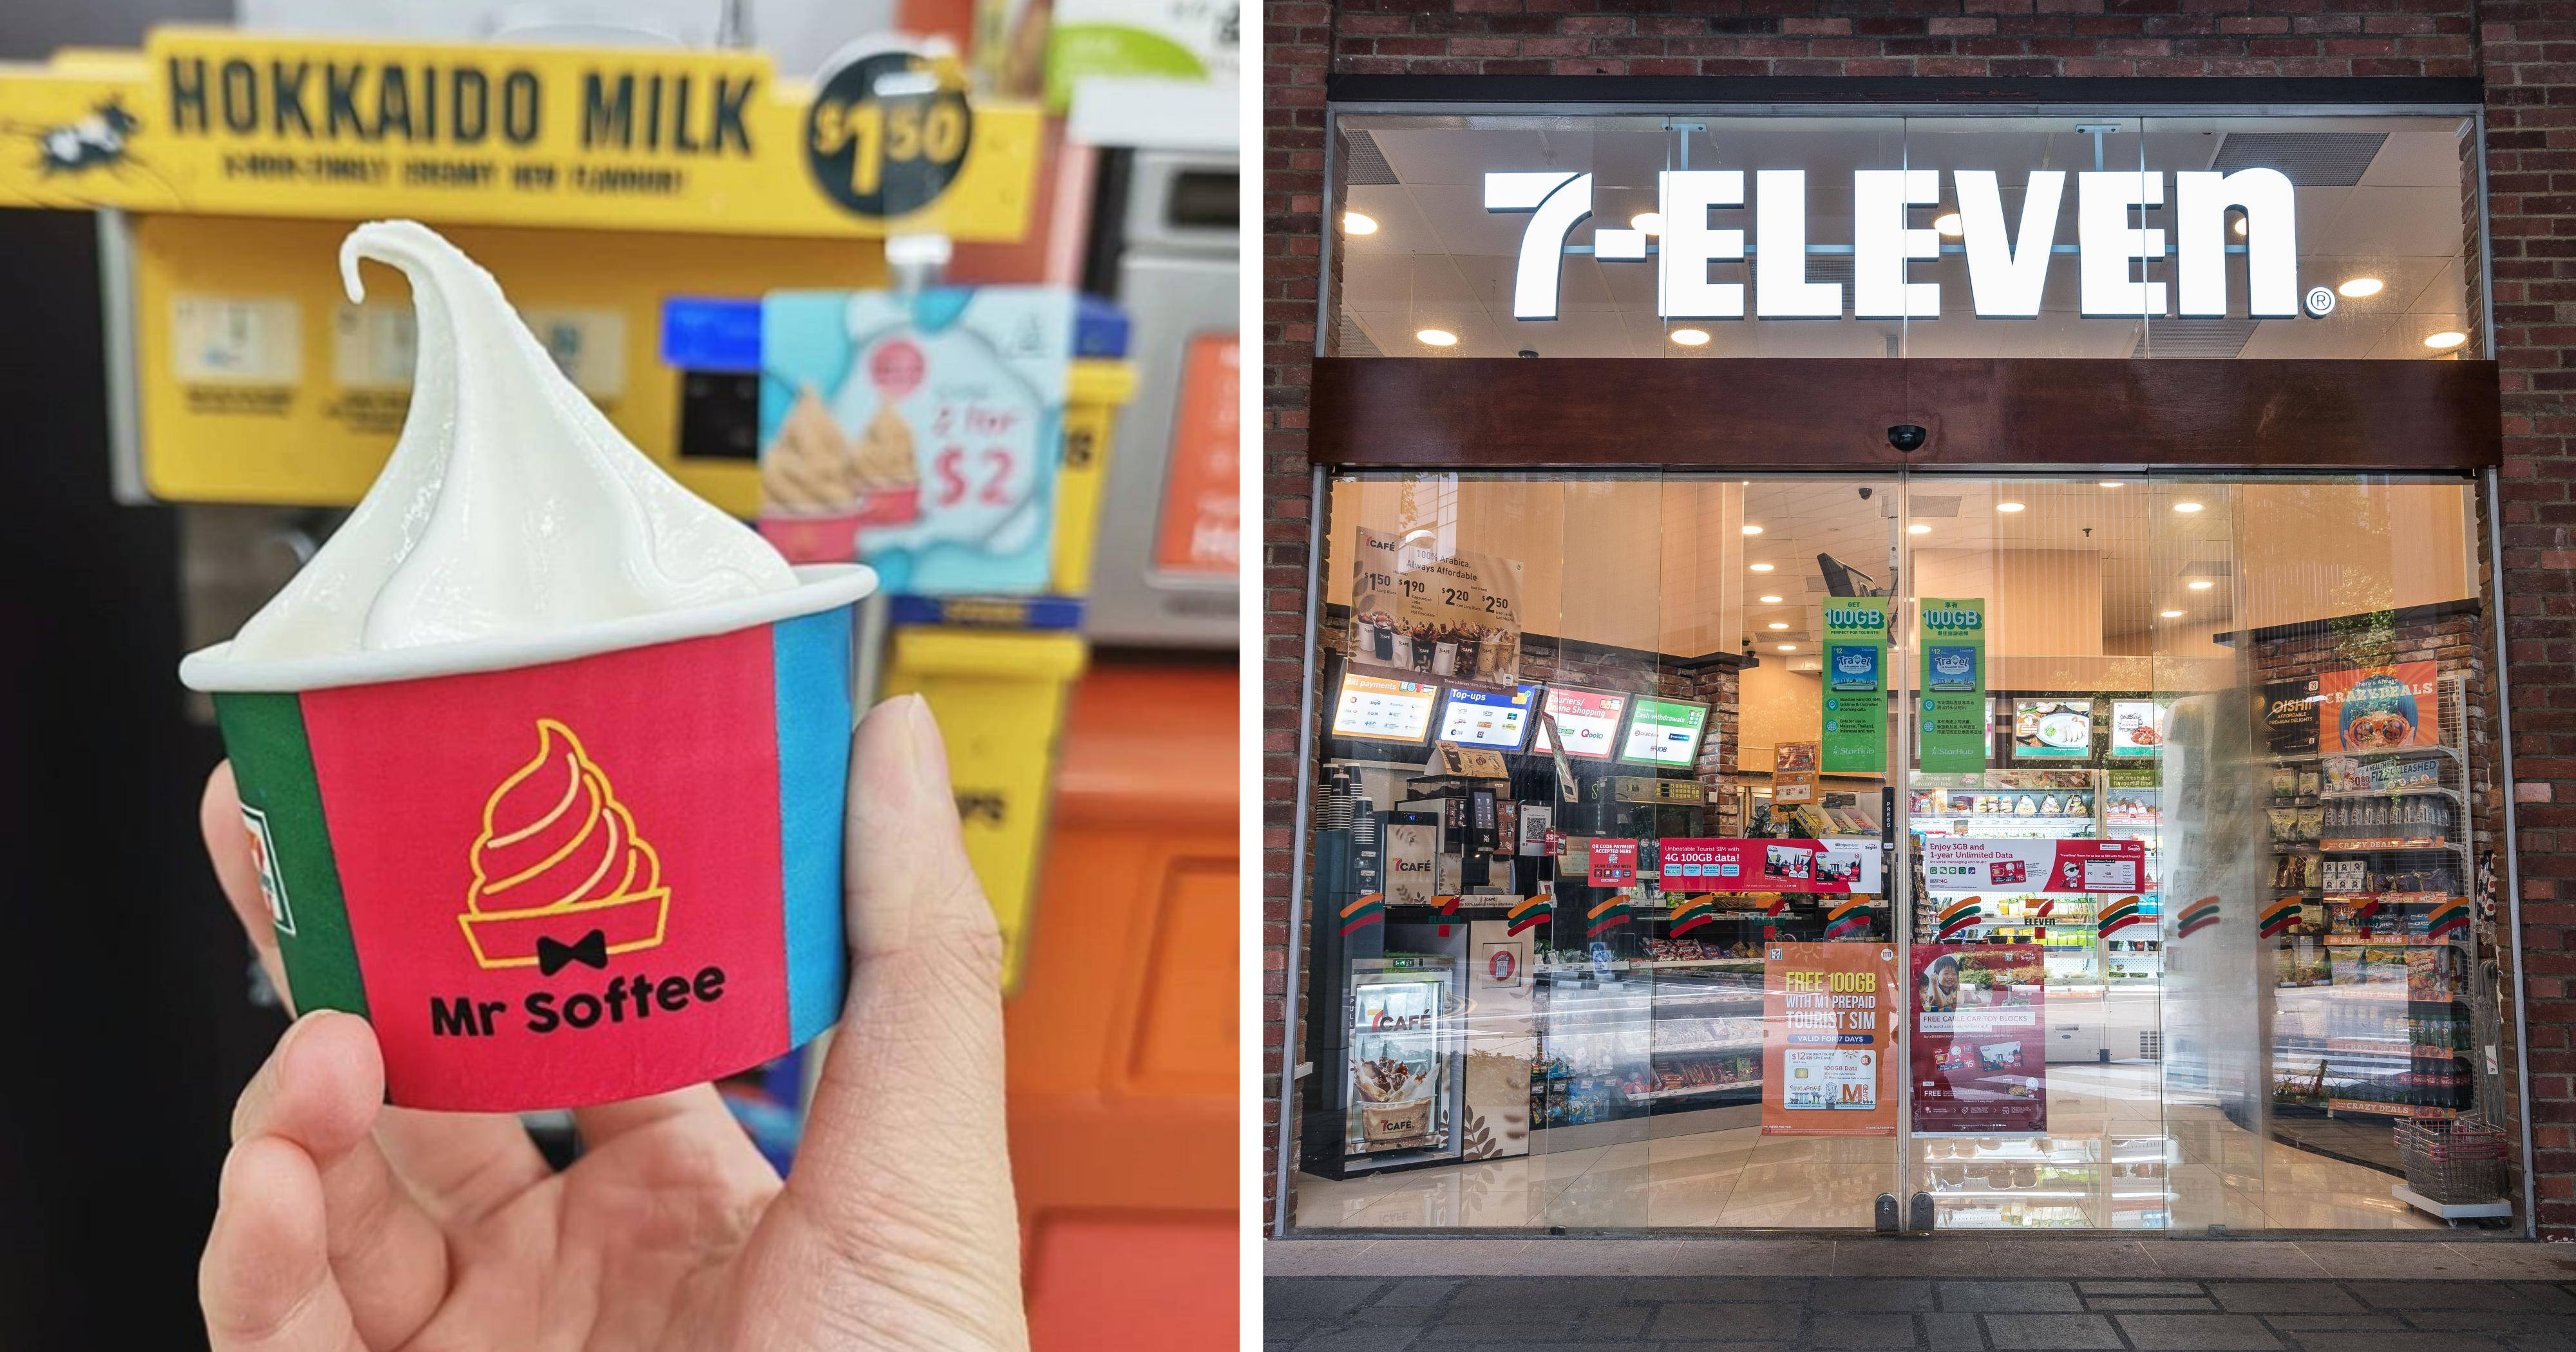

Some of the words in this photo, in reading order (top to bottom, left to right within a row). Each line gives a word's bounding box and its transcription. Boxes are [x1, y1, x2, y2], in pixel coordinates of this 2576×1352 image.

[168, 55, 542, 147] HOKKAIDO
[581, 71, 756, 158] MILK
[934, 449, 1014, 507] $2
[1417, 550, 1438, 561] 100%
[1440, 555, 1471, 569] Arabica,
[1406, 560, 1435, 573] Always
[1437, 567, 1477, 581] Affordable
[1825, 608, 1882, 626] 100GB
[1922, 609, 1978, 626] 100GB
[1345, 677, 1358, 686] Bill
[1360, 680, 1397, 690] payments
[1452, 689, 1486, 701] Top-ups
[1548, 695, 1586, 706] Couriers/
[2325, 688, 2377, 704] CRAZY
[2379, 682, 2433, 700] DEALS
[1572, 706, 1605, 718] Shopping
[1636, 711, 1650, 719] Cash
[2369, 760, 2395, 771] HEALTHIER
[2371, 770, 2390, 783] FIZZ
[2391, 760, 2438, 775] UNLEASHED
[1392, 858, 1431, 872] 7CAFÉ
[1665, 853, 1678, 861] 4G
[1681, 853, 1712, 861] 100GB
[1714, 853, 1739, 861] data!
[1786, 972, 1824, 993] FREE
[1828, 972, 1877, 993] 100GB
[429, 996, 506, 1037] Mr
[526, 966, 726, 1034] Softee
[1786, 995, 1812, 1009] WITH
[1815, 995, 1829, 1009] M1
[1832, 995, 1875, 1009] PREPAID
[1367, 1008, 1431, 1033] 7CAFÉ
[1786, 1011, 1846, 1030] TOURIST
[1849, 1011, 1875, 1030] SIM
[1792, 1052, 1806, 1060] $12
[1842, 1084, 1862, 1103] M
[2346, 1103, 2377, 1112] CRAZY
[2379, 1105, 2409, 1114] DEALS
[1380, 1119, 1412, 1132] 7CAFÉ
